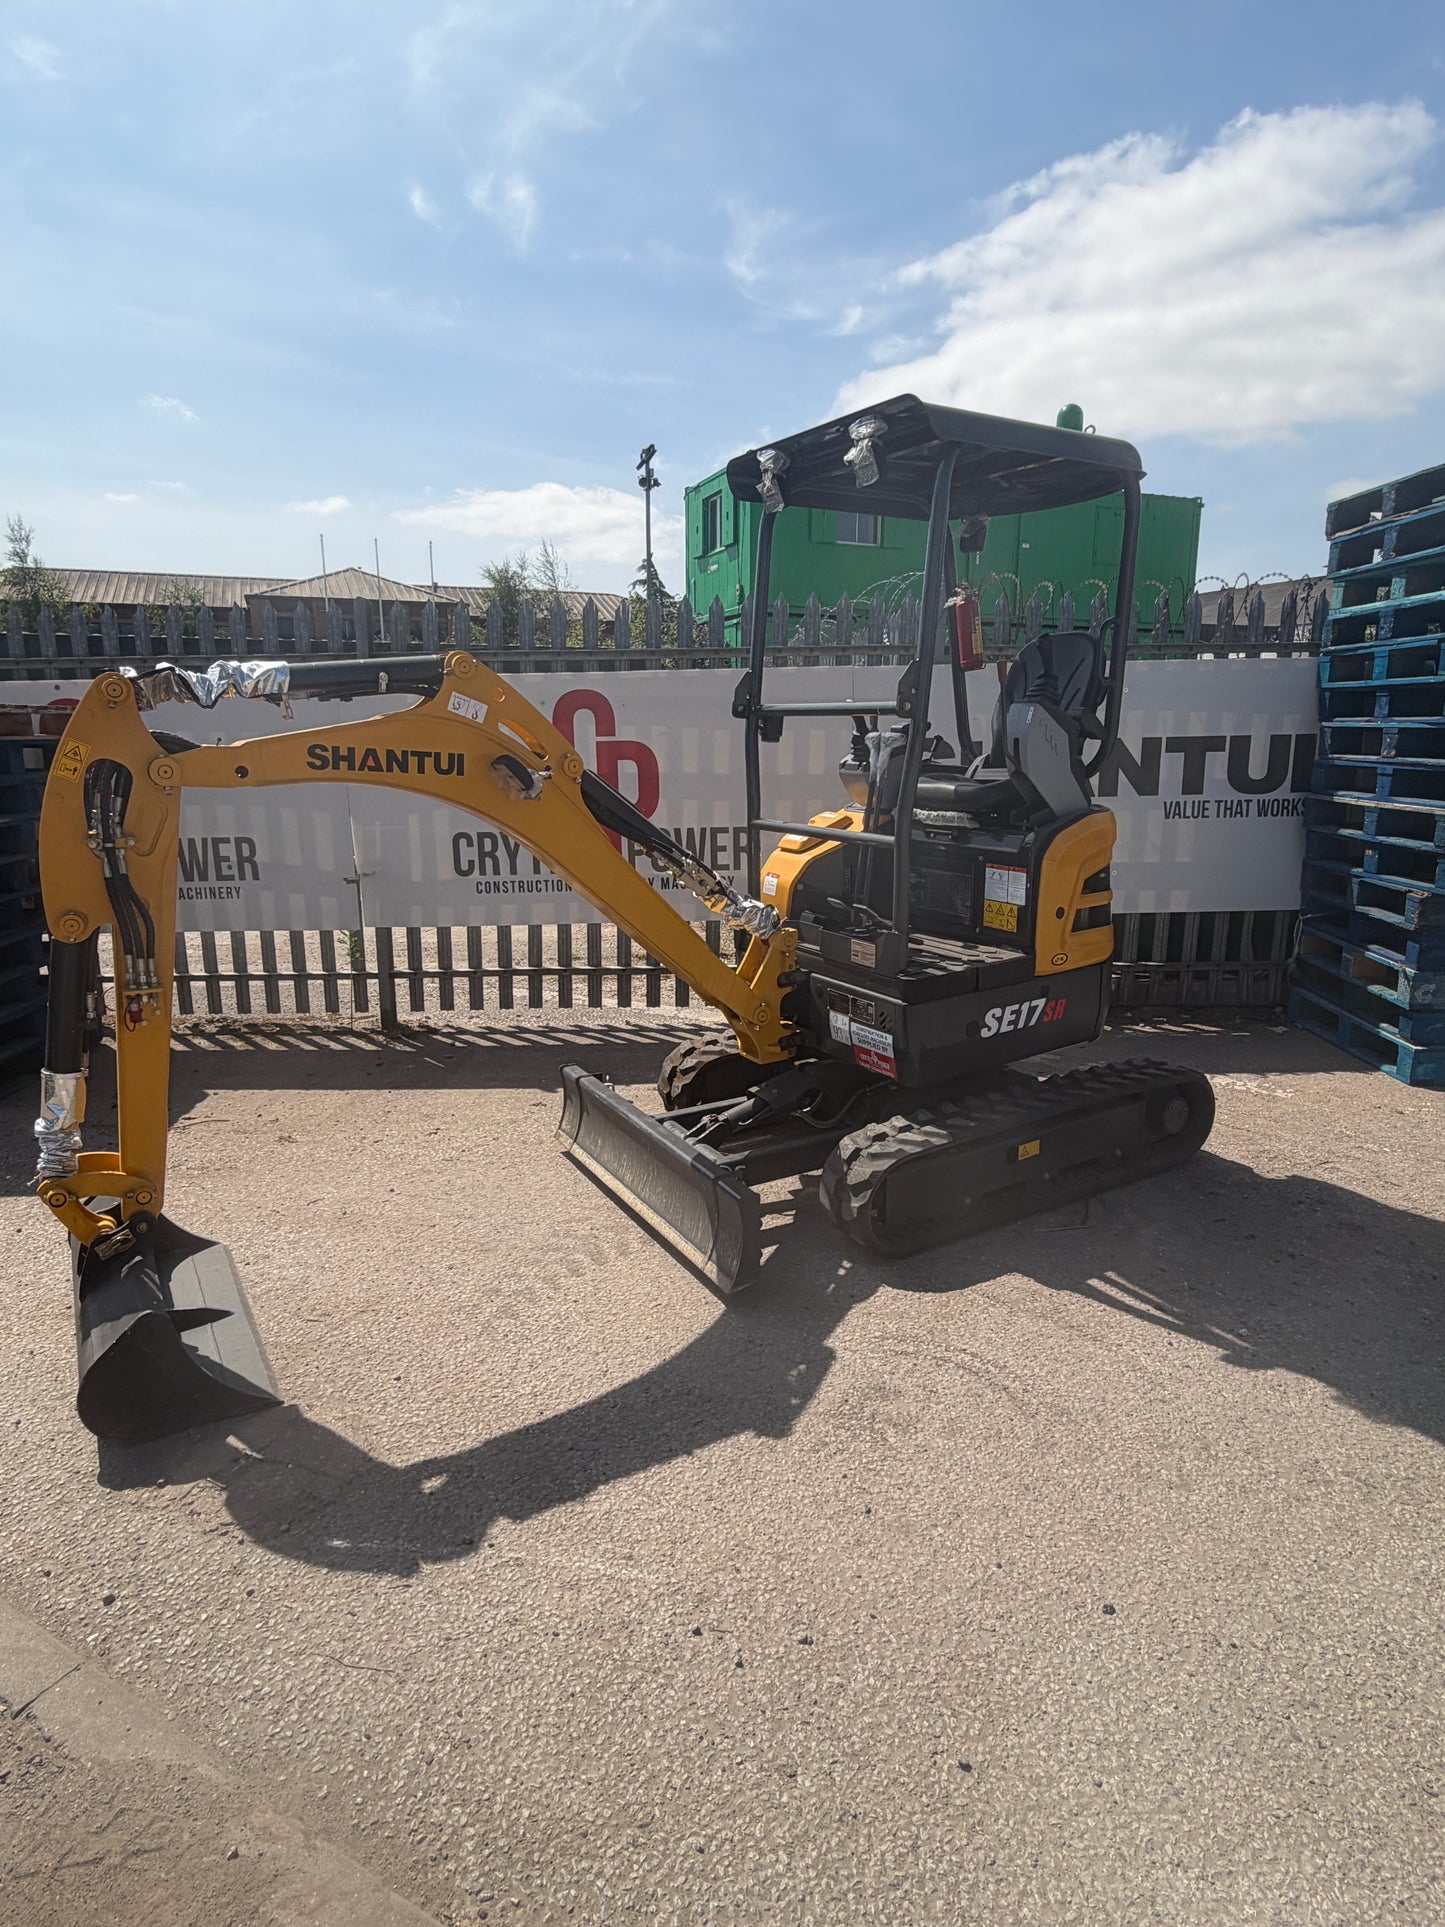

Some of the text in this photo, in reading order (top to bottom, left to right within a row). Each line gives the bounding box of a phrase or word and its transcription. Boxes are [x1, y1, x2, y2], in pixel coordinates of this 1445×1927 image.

[305, 743, 465, 776] SHANTUI
[1090, 734, 1318, 797] NTUI
[1163, 801, 1210, 819] VALUE
[1214, 800, 1253, 818] THAT
[178, 836, 260, 883] WER
[452, 831, 556, 877] CRY
[178, 886, 241, 900] ACHINERY
